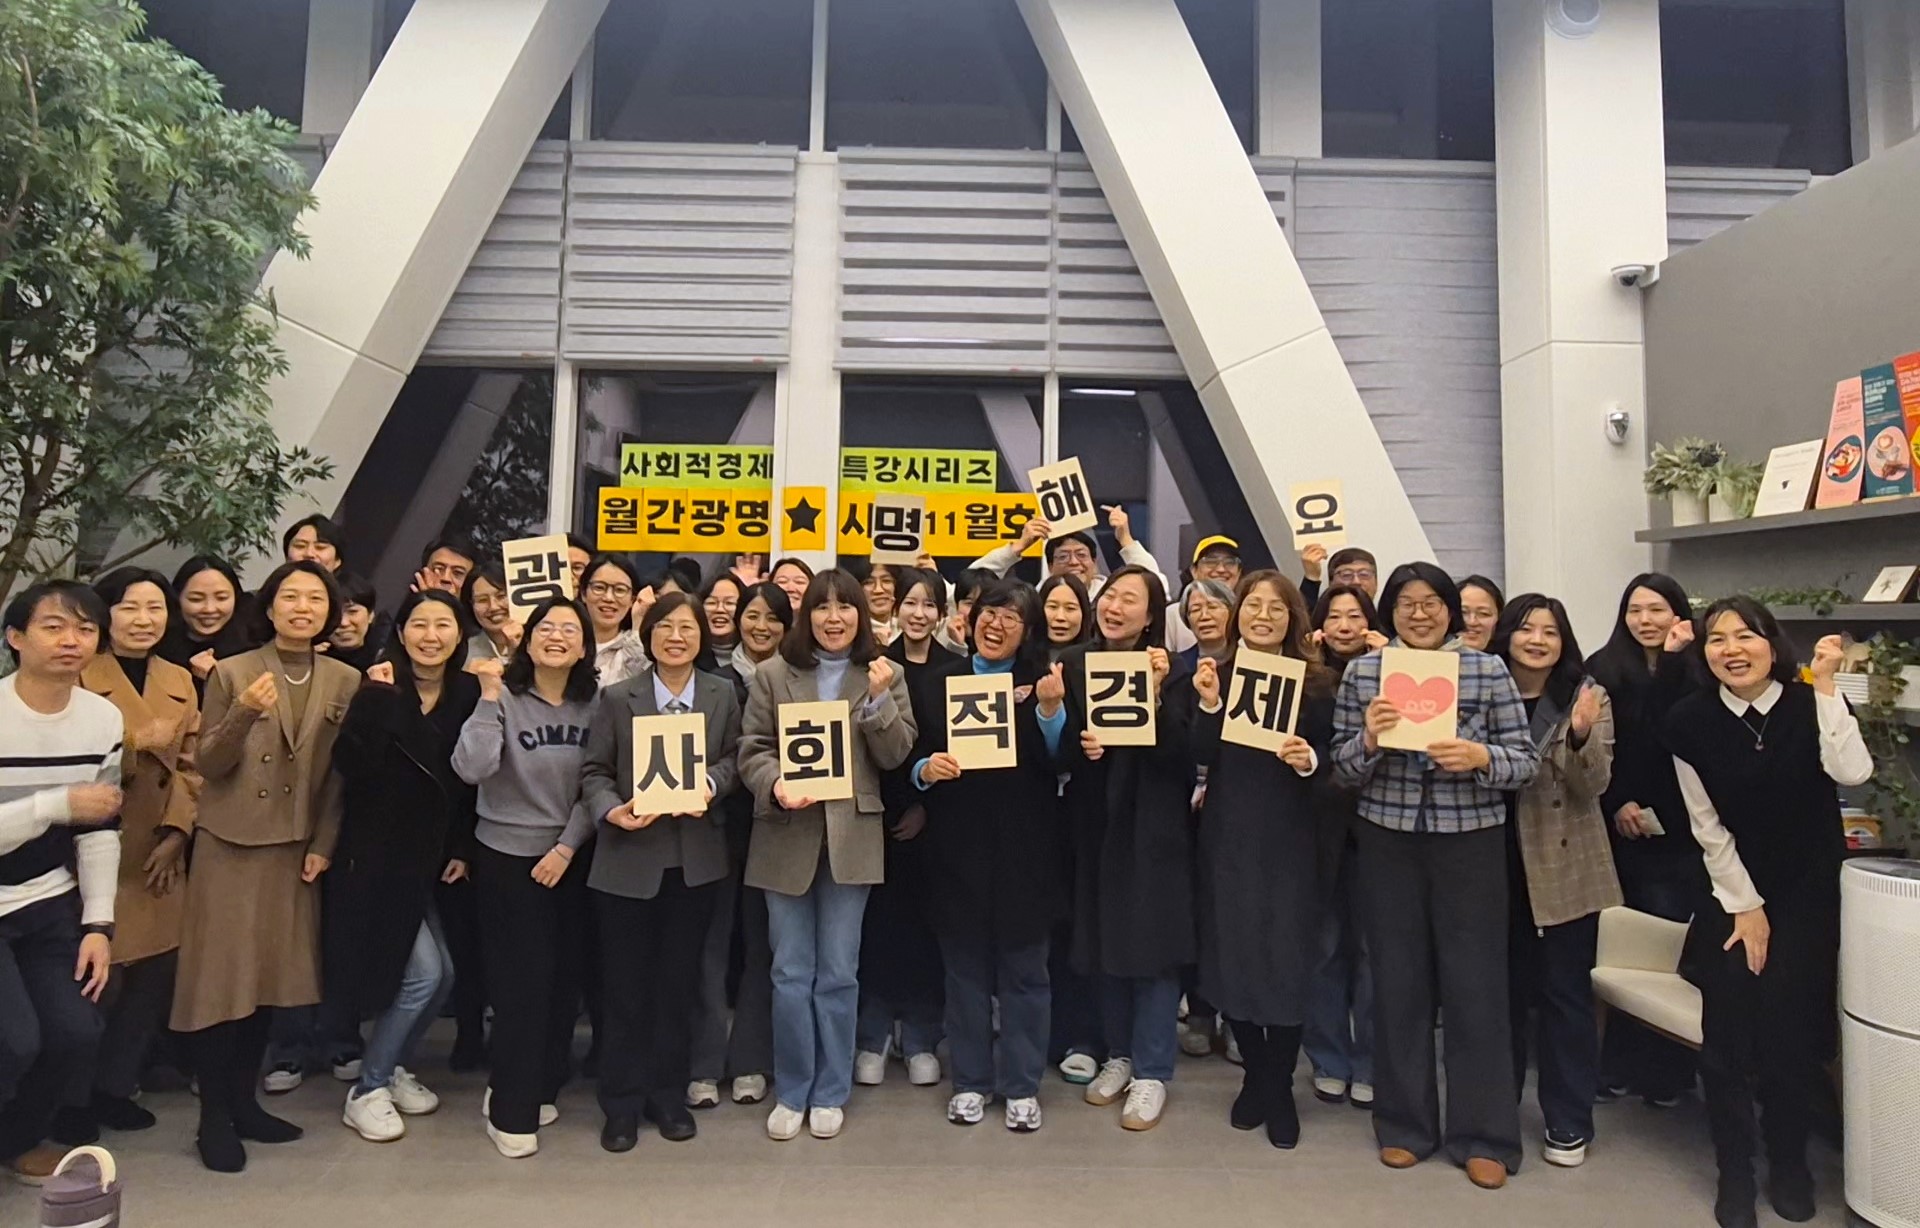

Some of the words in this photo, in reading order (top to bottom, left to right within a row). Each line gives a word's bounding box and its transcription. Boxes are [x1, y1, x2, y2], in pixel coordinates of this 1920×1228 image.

[622, 451, 774, 480] 사회적경제
[842, 456, 993, 484] 특강시리즈
[602, 497, 769, 537] 월간광명
[1036, 473, 1089, 522] 해
[1295, 493, 1343, 535] 요
[873, 506, 921, 552] 명
[508, 552, 568, 607] 광
[949, 691, 1009, 749] 적
[1089, 670, 1148, 728] 경
[1228, 667, 1297, 733] 제
[637, 733, 703, 792] 사
[783, 720, 844, 781] 회
